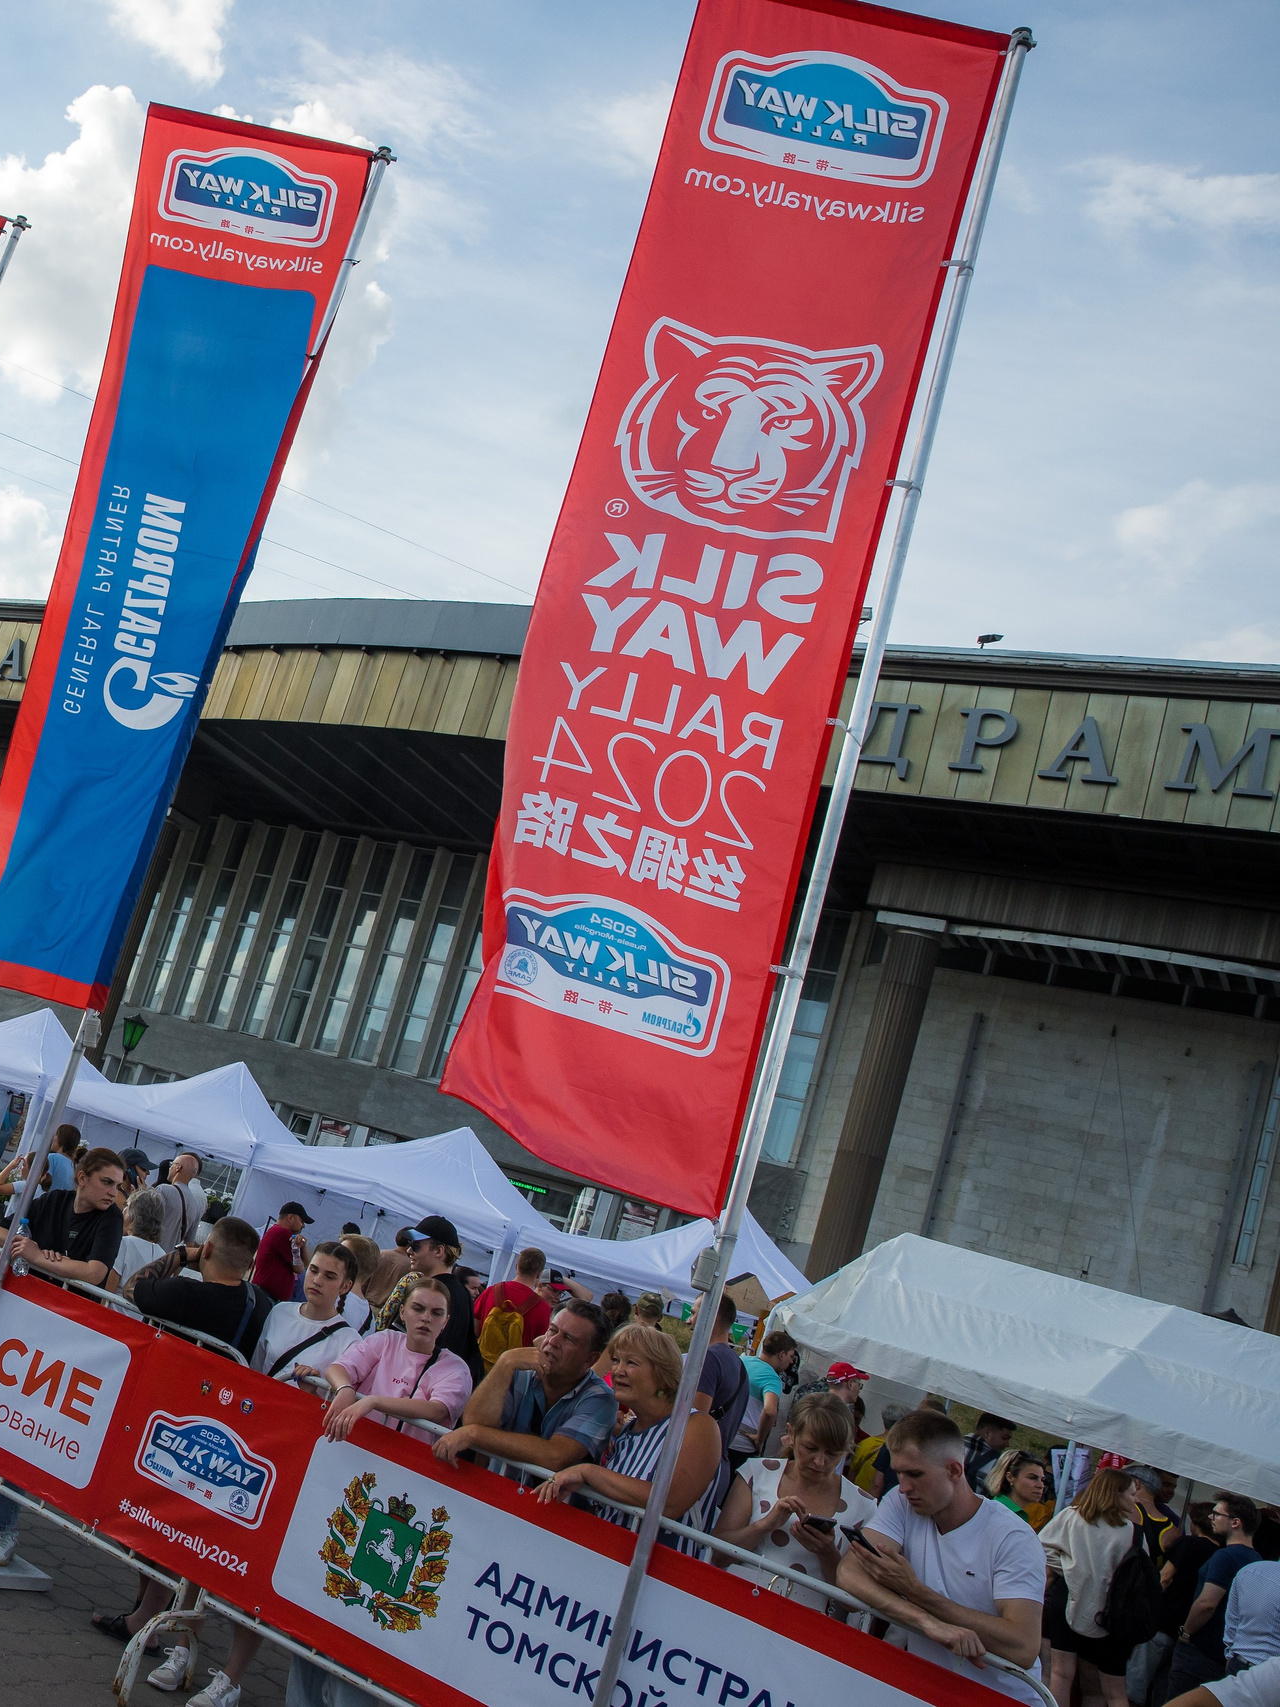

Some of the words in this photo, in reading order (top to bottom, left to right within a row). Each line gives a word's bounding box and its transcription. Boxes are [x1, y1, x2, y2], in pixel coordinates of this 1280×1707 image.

[156, 1429, 210, 1464] SILK
[210, 1452, 261, 1486] WAY
[199, 1428, 228, 1447] 2024
[152, 1461, 174, 1479] GAZPROM
[182, 1459, 223, 1483] RALLY
[118, 1498, 249, 1577] #silkwayrally2024
[474, 1561, 796, 1707] АДМИНИСТРА
